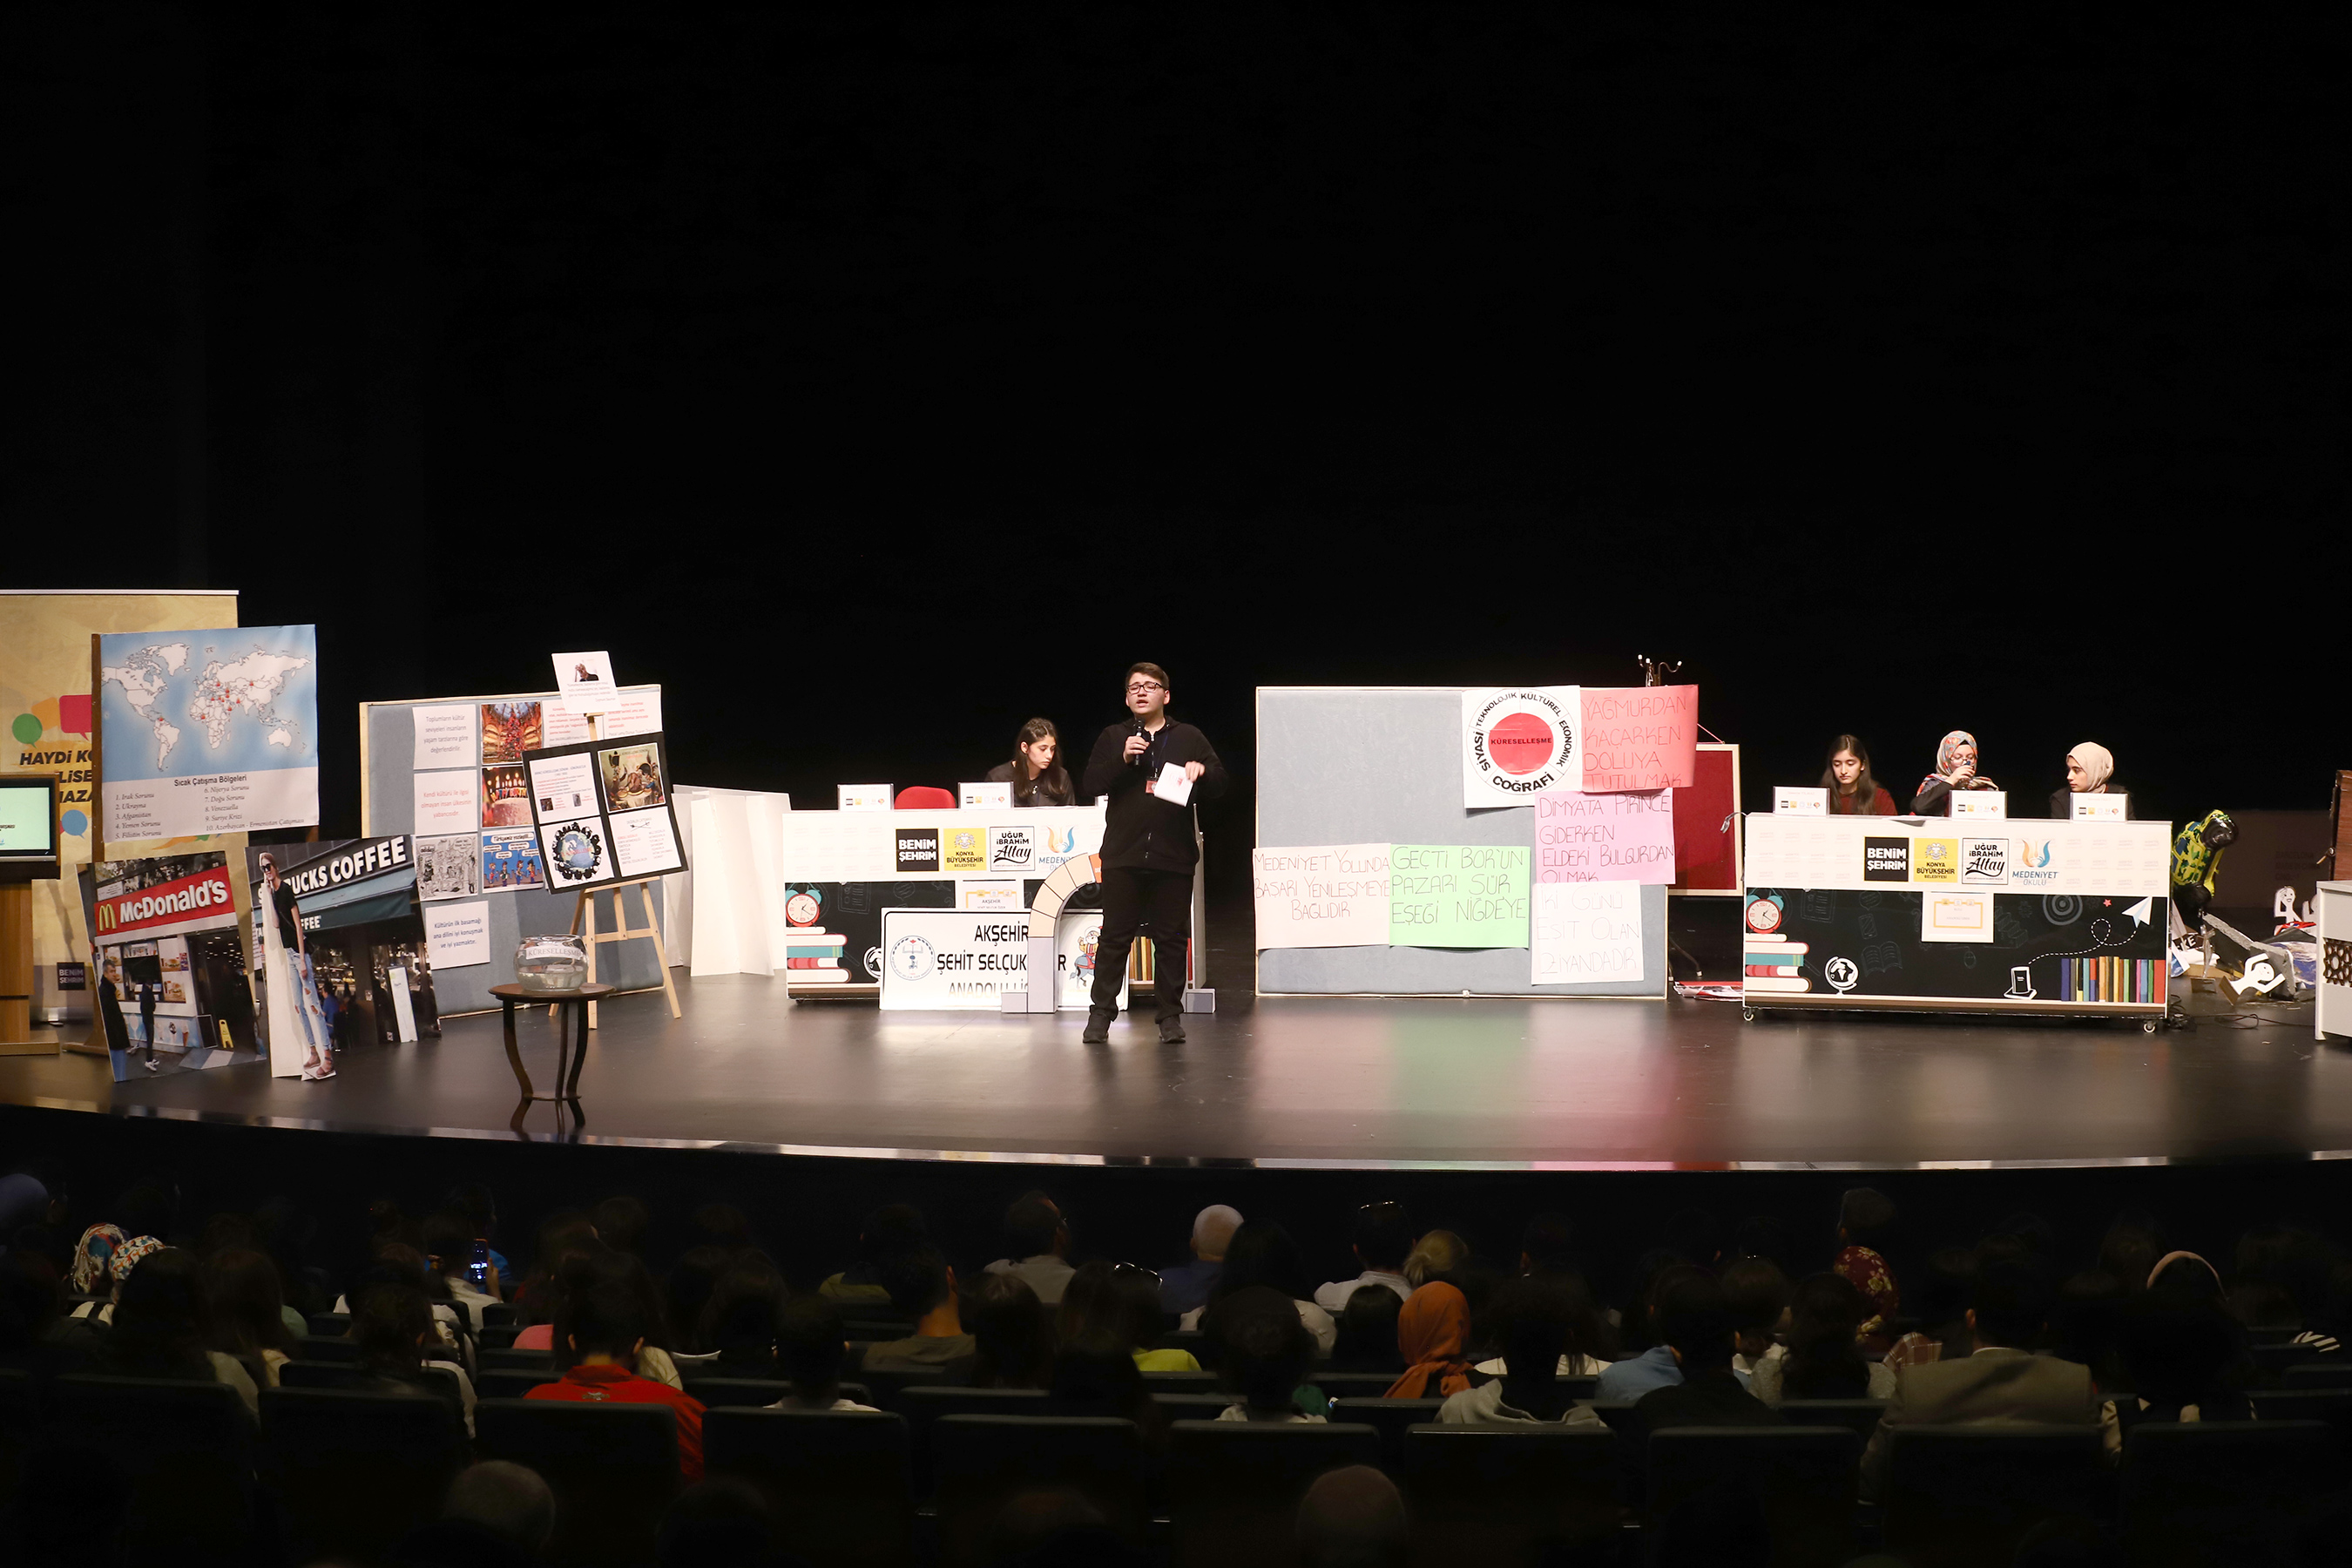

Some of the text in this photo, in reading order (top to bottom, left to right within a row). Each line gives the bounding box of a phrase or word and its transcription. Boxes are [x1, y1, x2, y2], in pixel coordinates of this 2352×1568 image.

[1520, 691, 1563, 717] KÜLTÜREL
[1581, 696, 1686, 721] YAĞMURDAN
[1556, 720, 1572, 767] EKONOMİK
[1585, 725, 1681, 749] KAÇARKEN
[19, 750, 92, 765] HAYDİ K
[1472, 731, 1491, 772] SİYASİ
[1584, 751, 1663, 772] DOLUYA
[174, 774, 247, 787] Sıcak Çatışma Bölgeleri
[1492, 771, 1555, 793] COĞRAFİ
[1584, 773, 1682, 792] TUTULMAK
[1539, 797, 1604, 818] DİMYATA
[898, 838, 936, 850] BENİM
[1002, 830, 1024, 839] UĞUR
[1539, 824, 1615, 845] GİDERKEN
[898, 851, 936, 862] ŞEHRİM
[993, 844, 1032, 864] Altay
[1543, 846, 1591, 867] ELDEKİ
[1867, 847, 1907, 860] BENİM
[1969, 849, 2004, 858] İBRAHİM
[1974, 842, 1997, 851] UĞUR
[329, 835, 408, 883] COFFEE
[1254, 849, 1390, 874] MEDENİYET YOLUNDA
[1392, 846, 1449, 870] GEÇTİ
[1867, 860, 1907, 872] ŞEHRİM
[1964, 857, 2005, 876] Altay
[1916, 867, 1956, 875] BÜYÜKŞEHİR
[2012, 870, 2058, 879] MEDENİYET
[1254, 875, 1390, 899] BAŞARI YENİLEŞMEYE
[1392, 874, 1511, 896] PAZARI SÜR
[120, 879, 228, 923] McDonald's
[1540, 884, 1623, 911] İKİ GÜNÜ
[1392, 900, 1440, 926] EŞEĞİ
[434, 919, 453, 929] Kültürün
[975, 921, 1029, 947] AKŞEHİR
[1592, 916, 1639, 941] OLAN
[528, 948, 581, 957] KÜRESELLEŞME
[937, 950, 974, 975] ŞEHİT
[978, 953, 1027, 976] SELÇUK
